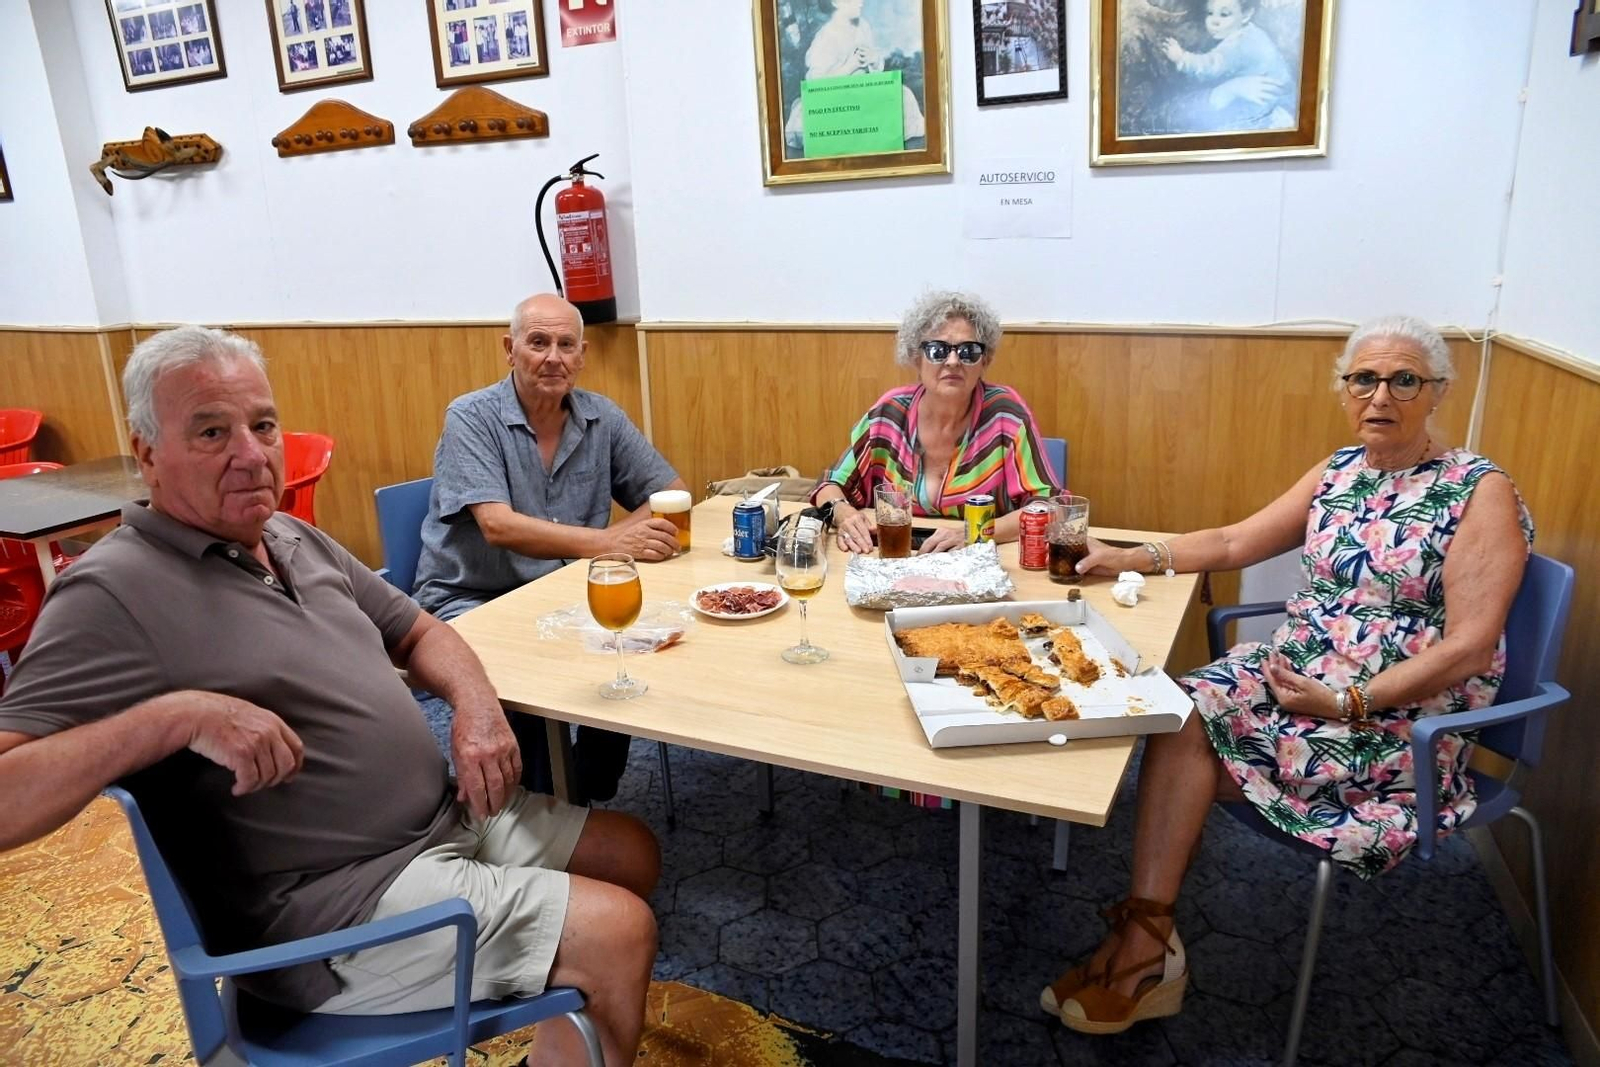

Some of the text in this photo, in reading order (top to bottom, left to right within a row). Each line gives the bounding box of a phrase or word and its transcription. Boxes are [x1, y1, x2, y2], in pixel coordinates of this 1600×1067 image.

[566, 22, 611, 38] EXTINTOR
[808, 108, 823, 116] PAGO
[832, 105, 860, 113] EFECTIVO
[826, 128, 851, 136] ACEPTAN
[852, 126, 879, 135] TARJETAS
[979, 171, 1056, 184] AUTOSERVICIO
[1000, 198, 1010, 206] EN
